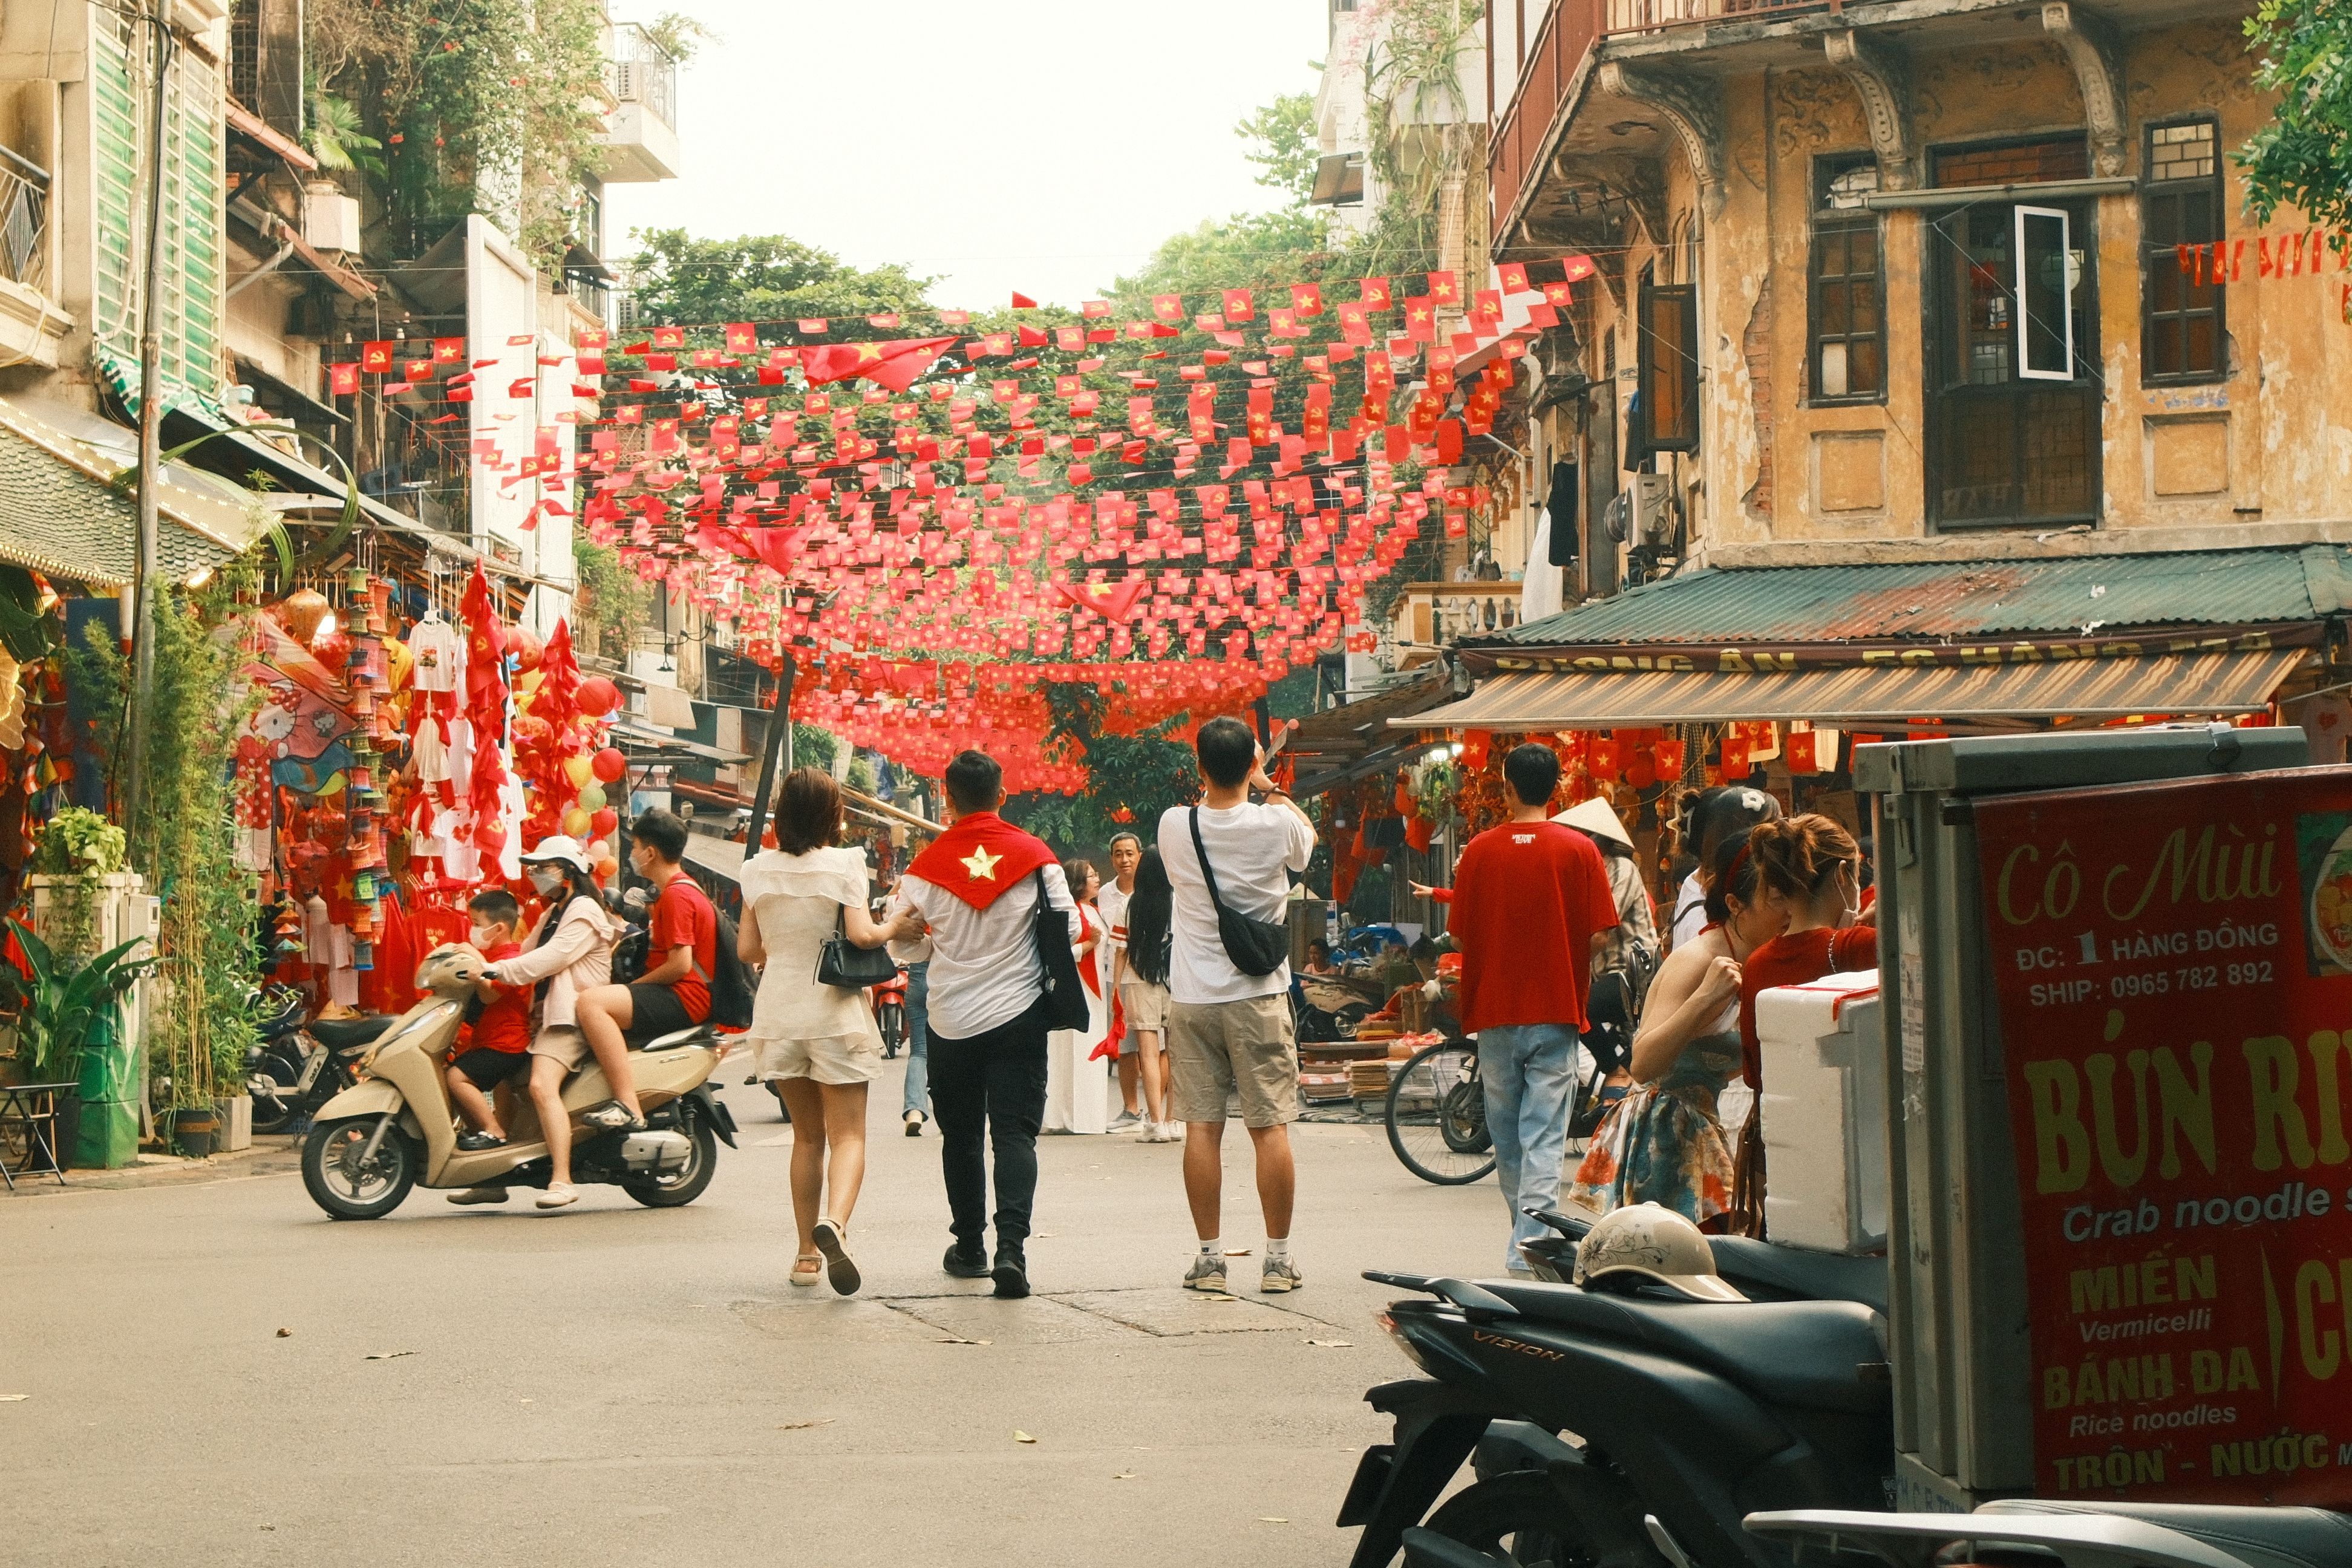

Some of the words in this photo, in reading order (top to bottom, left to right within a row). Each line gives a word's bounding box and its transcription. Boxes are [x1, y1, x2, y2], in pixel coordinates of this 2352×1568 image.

[1997, 838, 2080, 925] Cô
[2103, 823, 2282, 921] Mùi
[2016, 946, 2066, 972] ĐC:
[2073, 930, 2103, 965] 1
[2111, 930, 2189, 961] HÀNG
[2195, 917, 2279, 952] ĐỒNG
[2029, 979, 2102, 1007] SHIP:
[2110, 972, 2170, 998] 0965
[2177, 966, 2218, 990] 782
[2227, 960, 2274, 985] 892
[2023, 1008, 2217, 1195] BÚN
[2242, 1029, 2352, 1172] RI
[2063, 1197, 2160, 1242] Crab
[2174, 1181, 2330, 1229] noodle
[2069, 1242, 2217, 1314] MIẾN
[1474, 1330, 1566, 1361] VISION
[2079, 1308, 2212, 1343] Vermicelli
[2042, 1351, 2174, 1411] BÁNH
[2189, 1347, 2260, 1395] ĐA
[2069, 1413, 2124, 1438] Rice
[2132, 1405, 2236, 1431] noodles
[2053, 1444, 2165, 1494] TRỘN
[2210, 1426, 2329, 1477] NƯỚC
